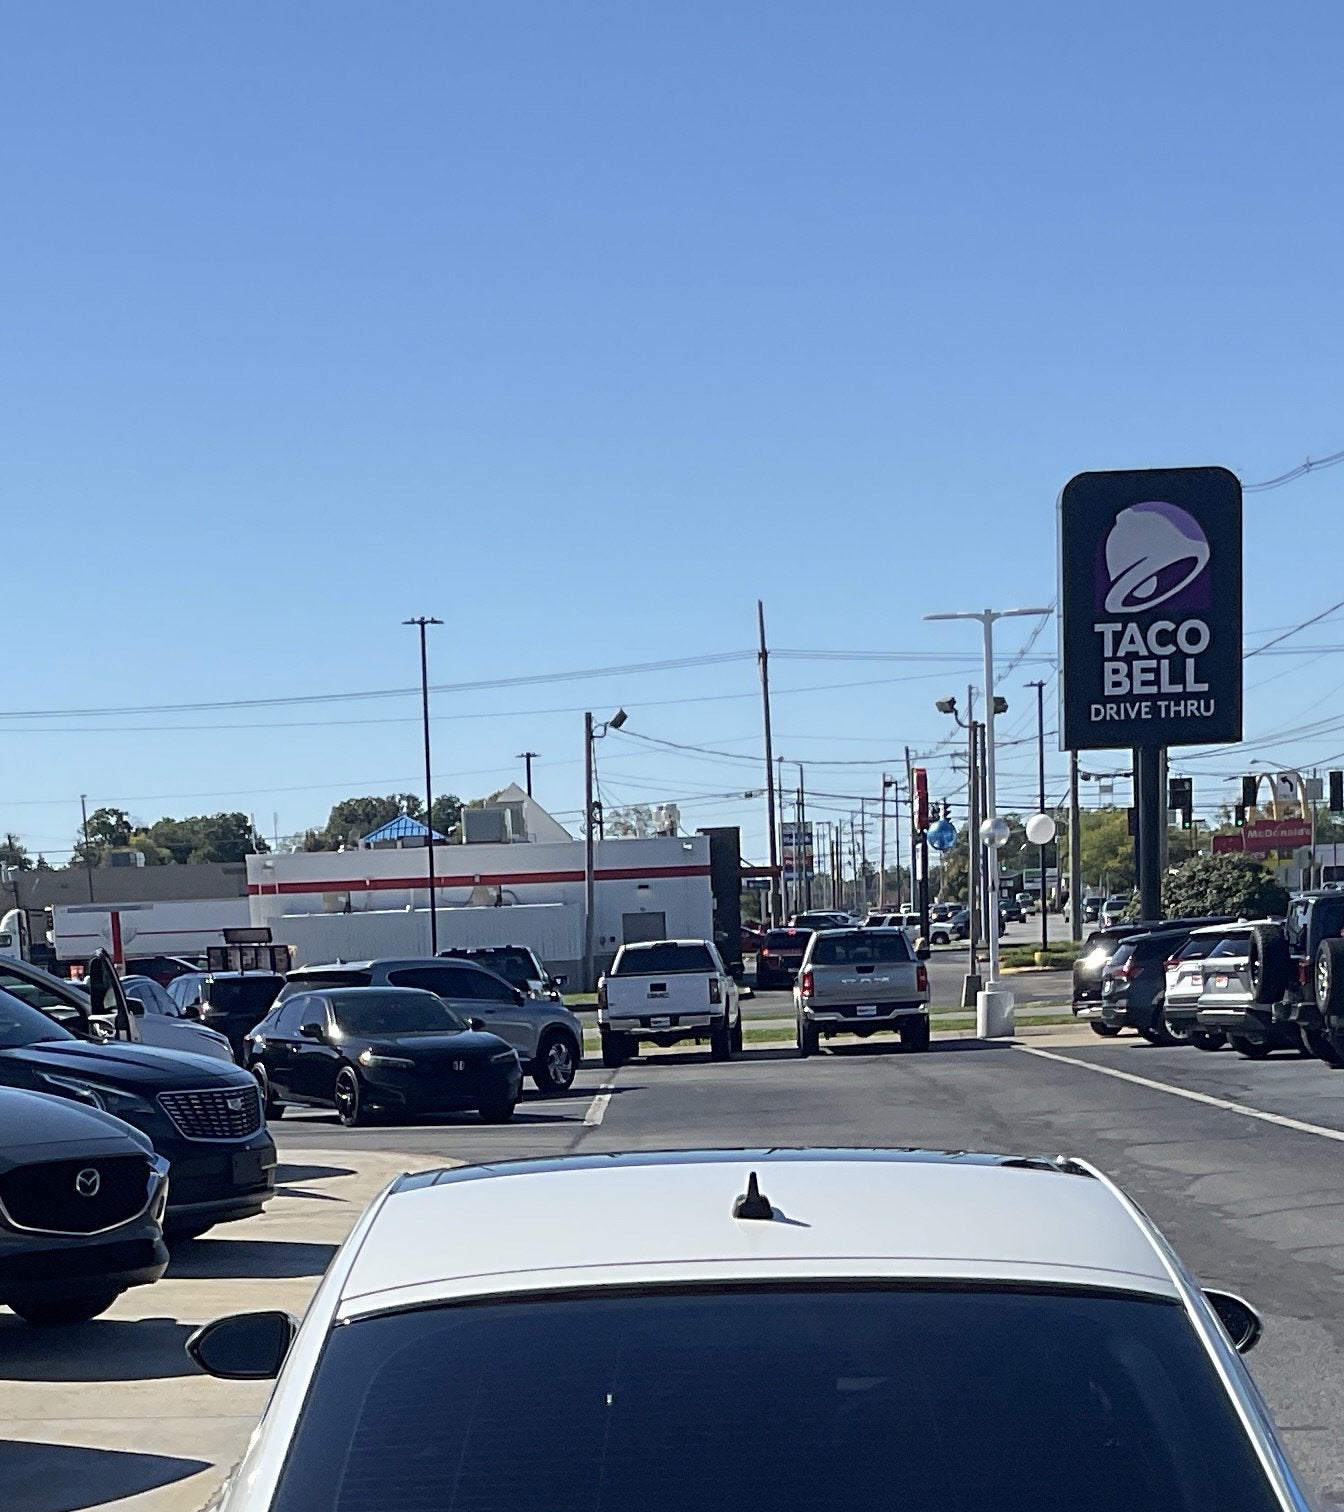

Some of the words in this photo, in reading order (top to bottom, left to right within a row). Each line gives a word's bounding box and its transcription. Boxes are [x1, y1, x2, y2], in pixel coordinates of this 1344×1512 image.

[1094, 619, 1210, 658] TACO
[1104, 658, 1209, 696] BELL
[1090, 701, 1152, 721] DRIVE
[1156, 699, 1215, 718] THRU
